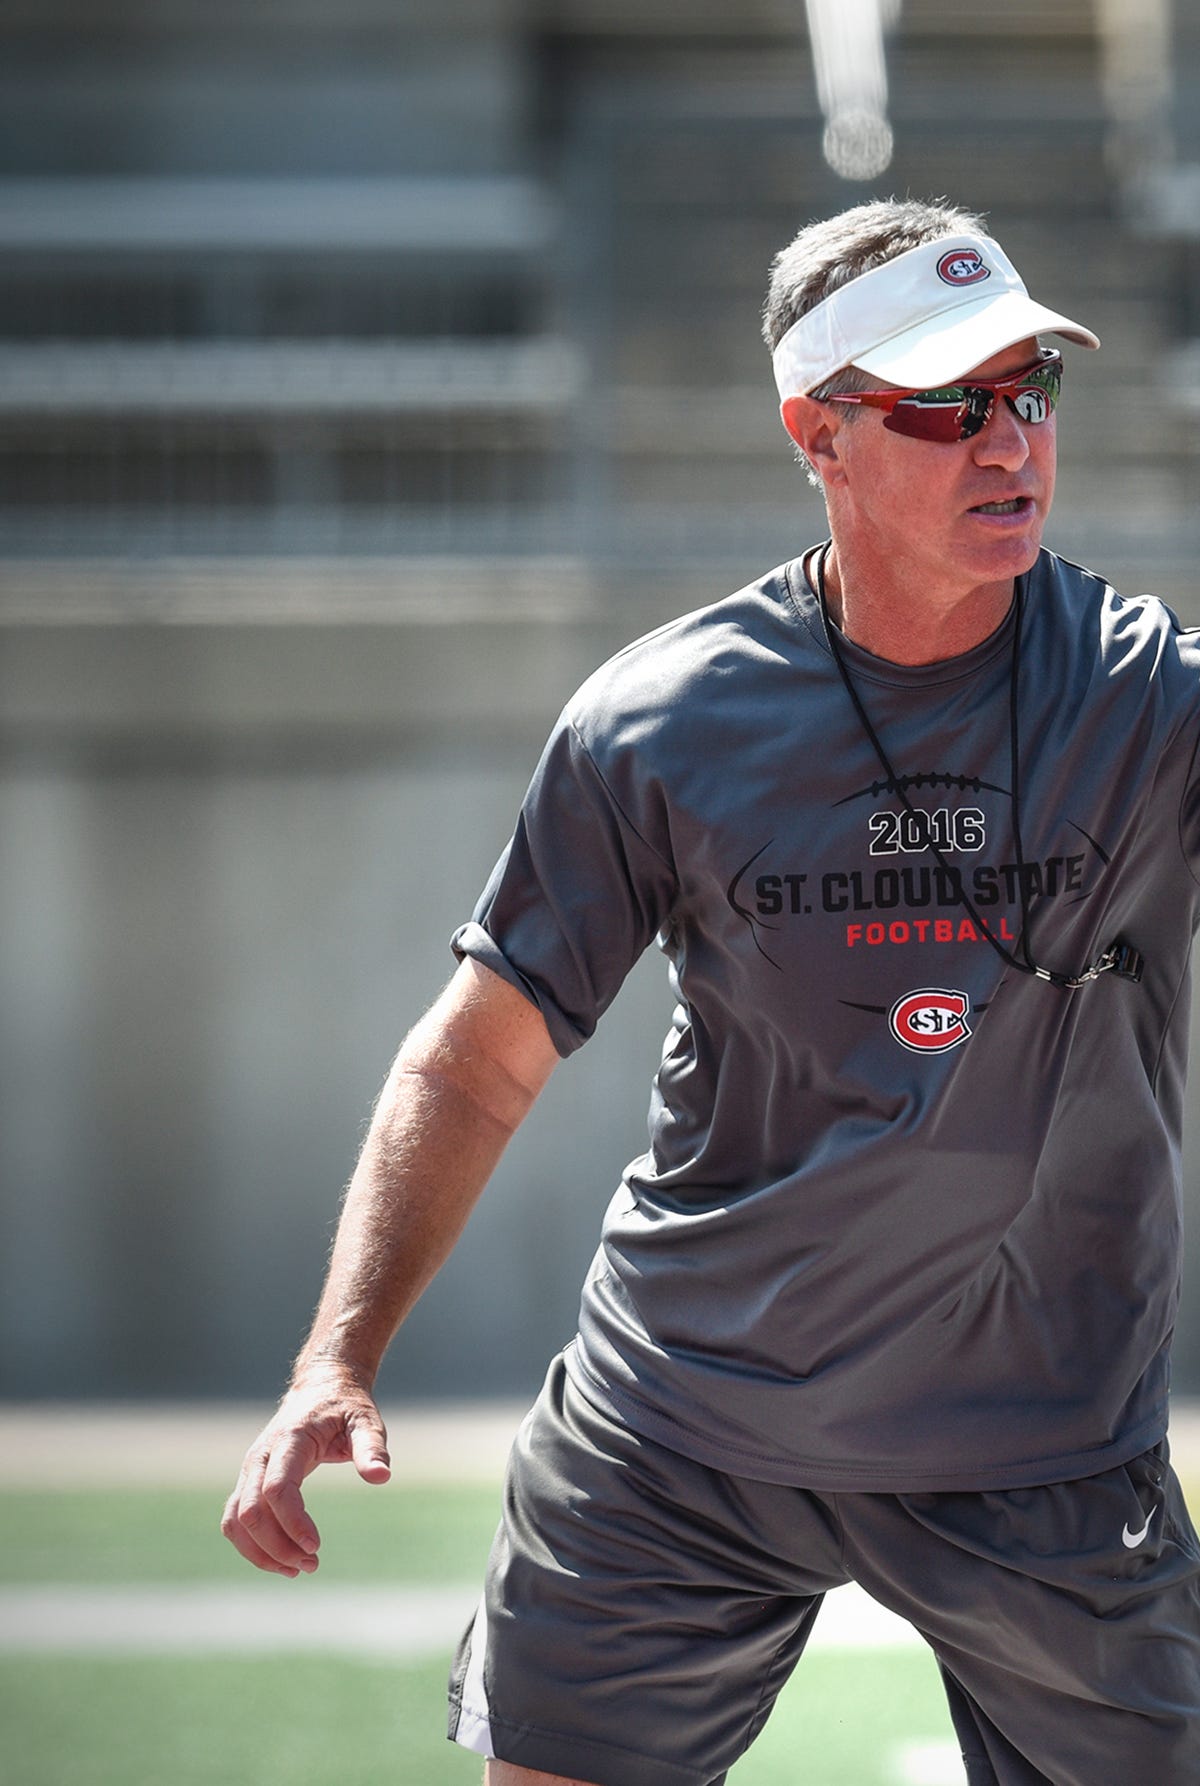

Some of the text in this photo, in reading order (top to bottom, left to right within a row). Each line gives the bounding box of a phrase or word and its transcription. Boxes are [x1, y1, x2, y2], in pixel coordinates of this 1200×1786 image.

[868, 807, 985, 856] 2016
[755, 854, 1086, 915] ST. CLOUD STATE
